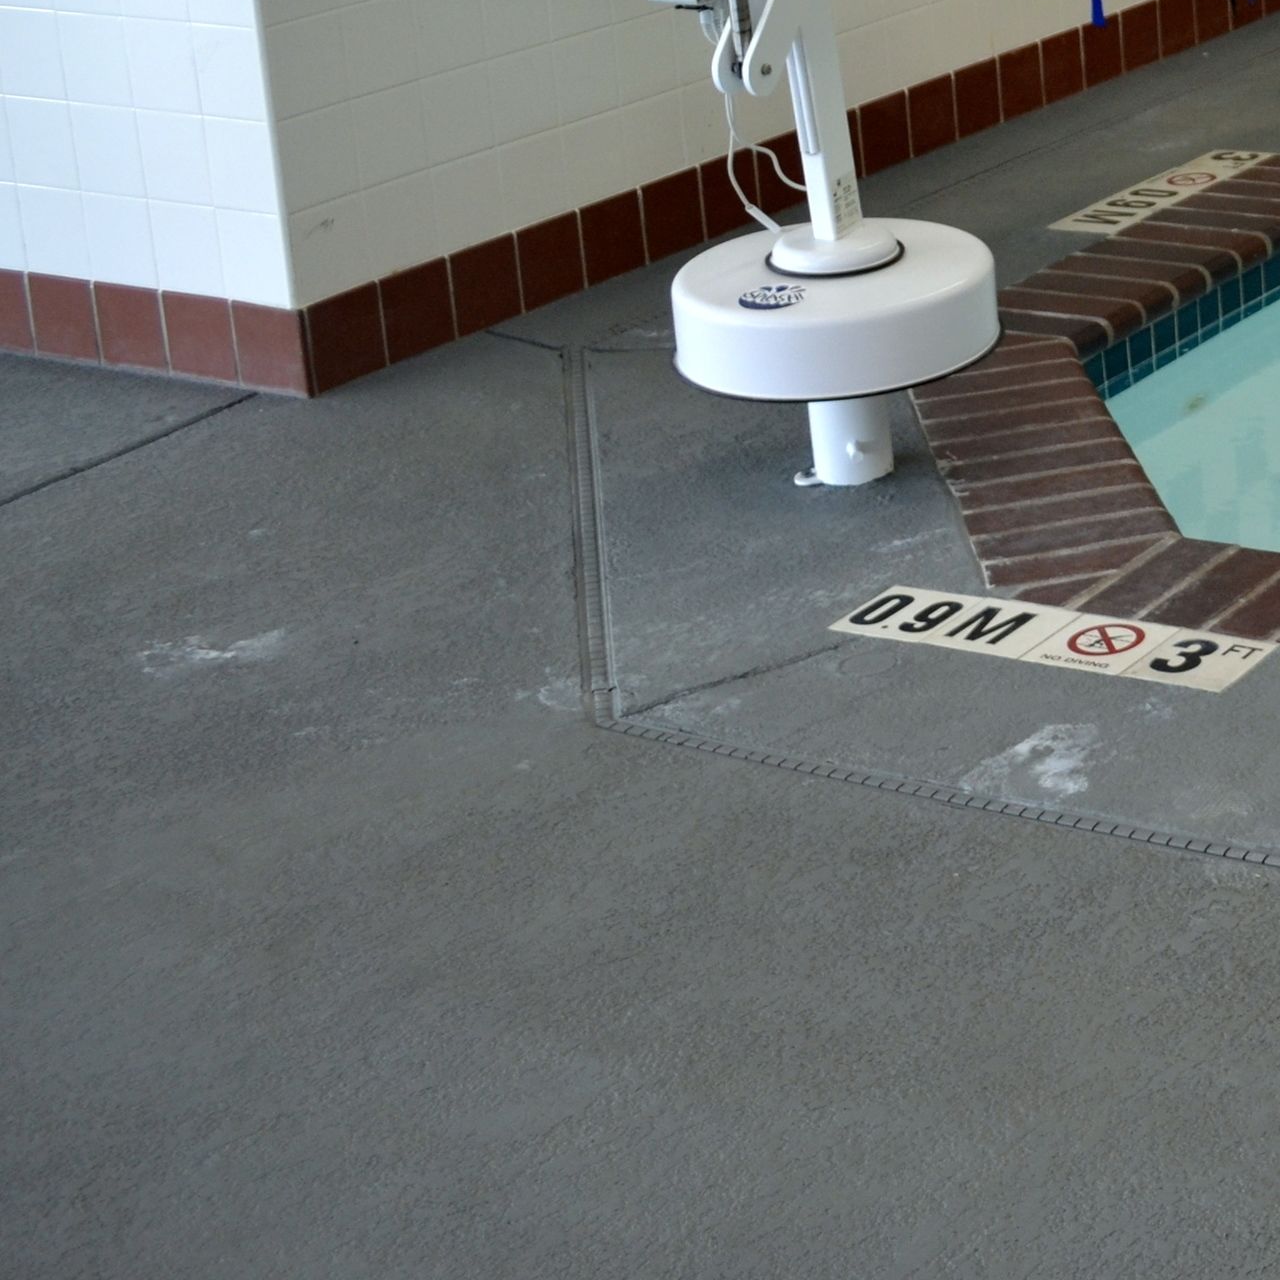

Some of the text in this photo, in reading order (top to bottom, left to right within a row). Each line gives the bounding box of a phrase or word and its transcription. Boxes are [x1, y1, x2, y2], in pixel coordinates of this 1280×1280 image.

[848, 593, 1037, 645] 0.9M
[1040, 652, 1111, 670] NO DIVING
[1149, 638, 1264, 674] 3 FT
